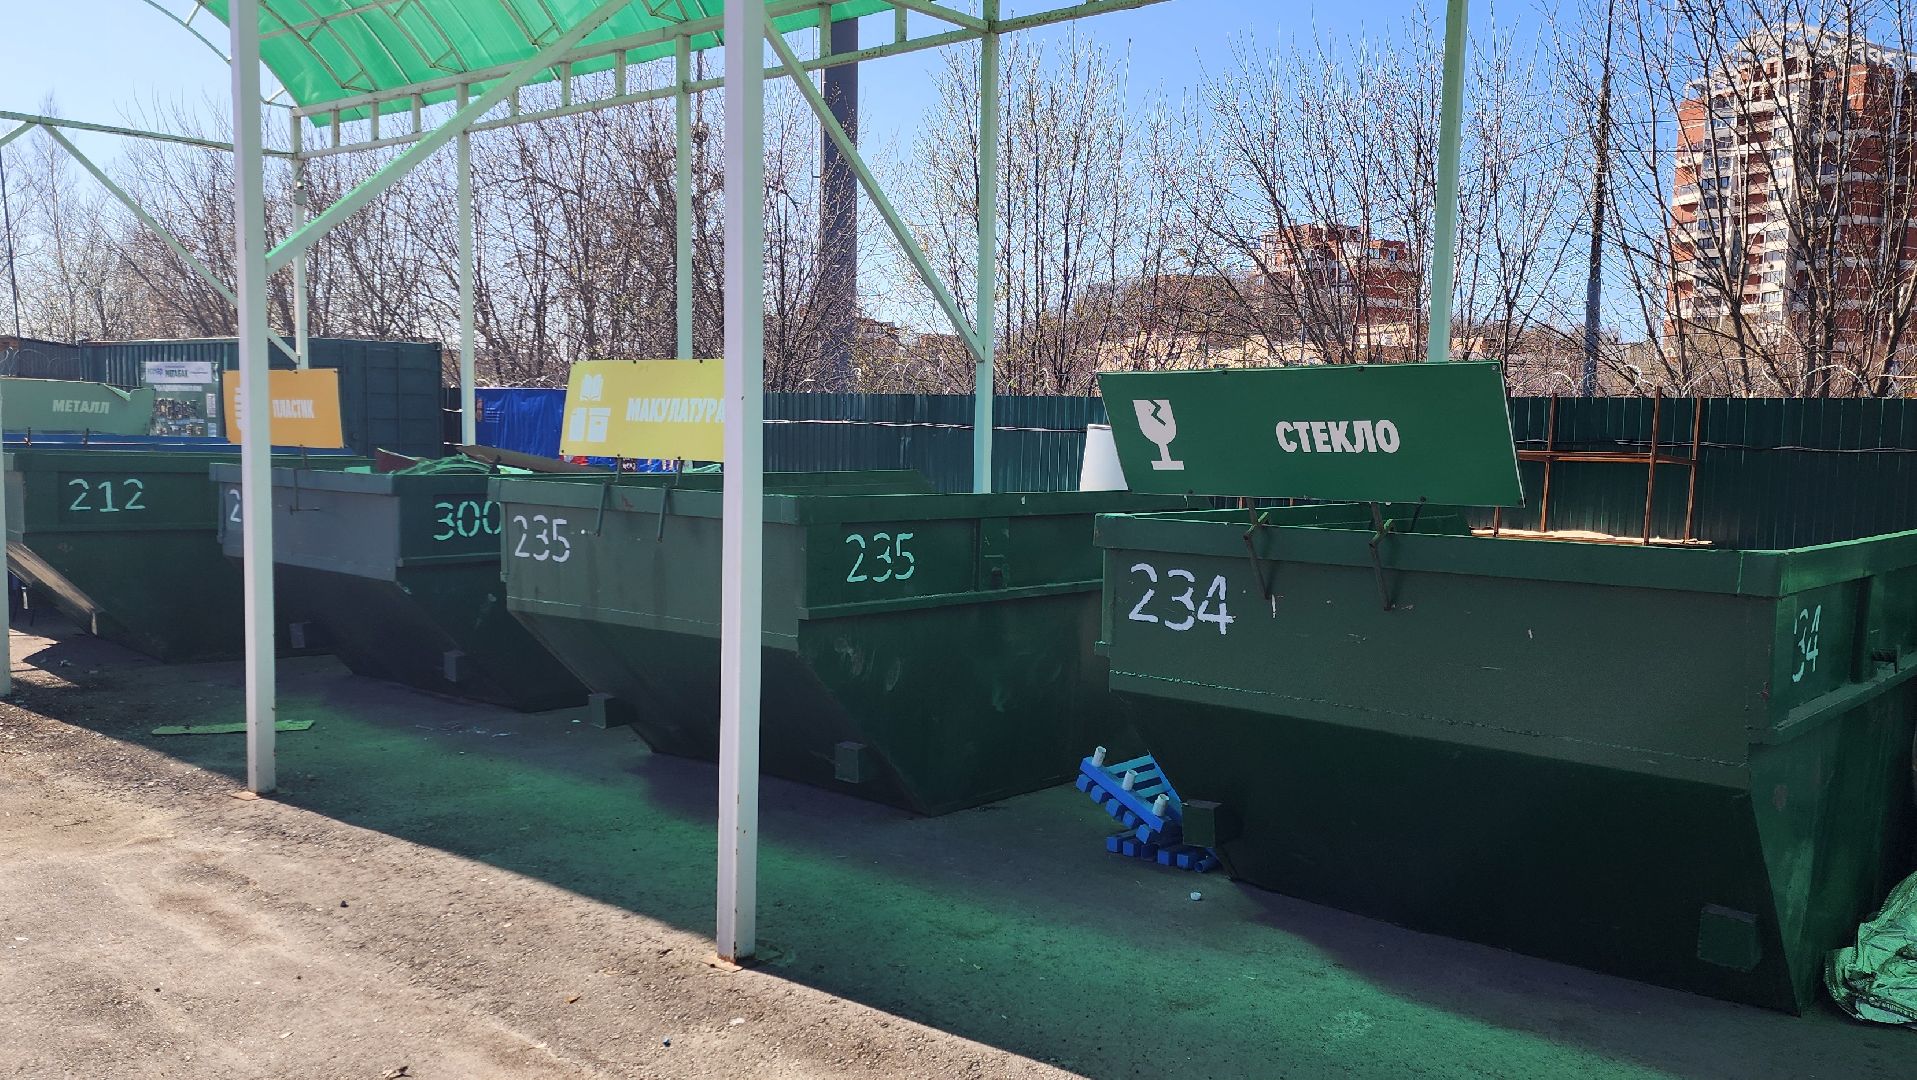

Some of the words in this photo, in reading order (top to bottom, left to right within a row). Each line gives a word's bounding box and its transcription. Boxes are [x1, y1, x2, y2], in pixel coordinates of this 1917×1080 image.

[52, 399, 110, 414] МЕТАЛЛ
[272, 399, 315, 419] ПЛАСТИК
[1275, 419, 1401, 454] СТЕКЛО
[68, 478, 146, 512] 212
[433, 500, 501, 541] 300
[513, 514, 571, 563] 235
[845, 532, 915, 583] 235
[1128, 562, 1235, 635] 234
[1791, 604, 1822, 683] 34
